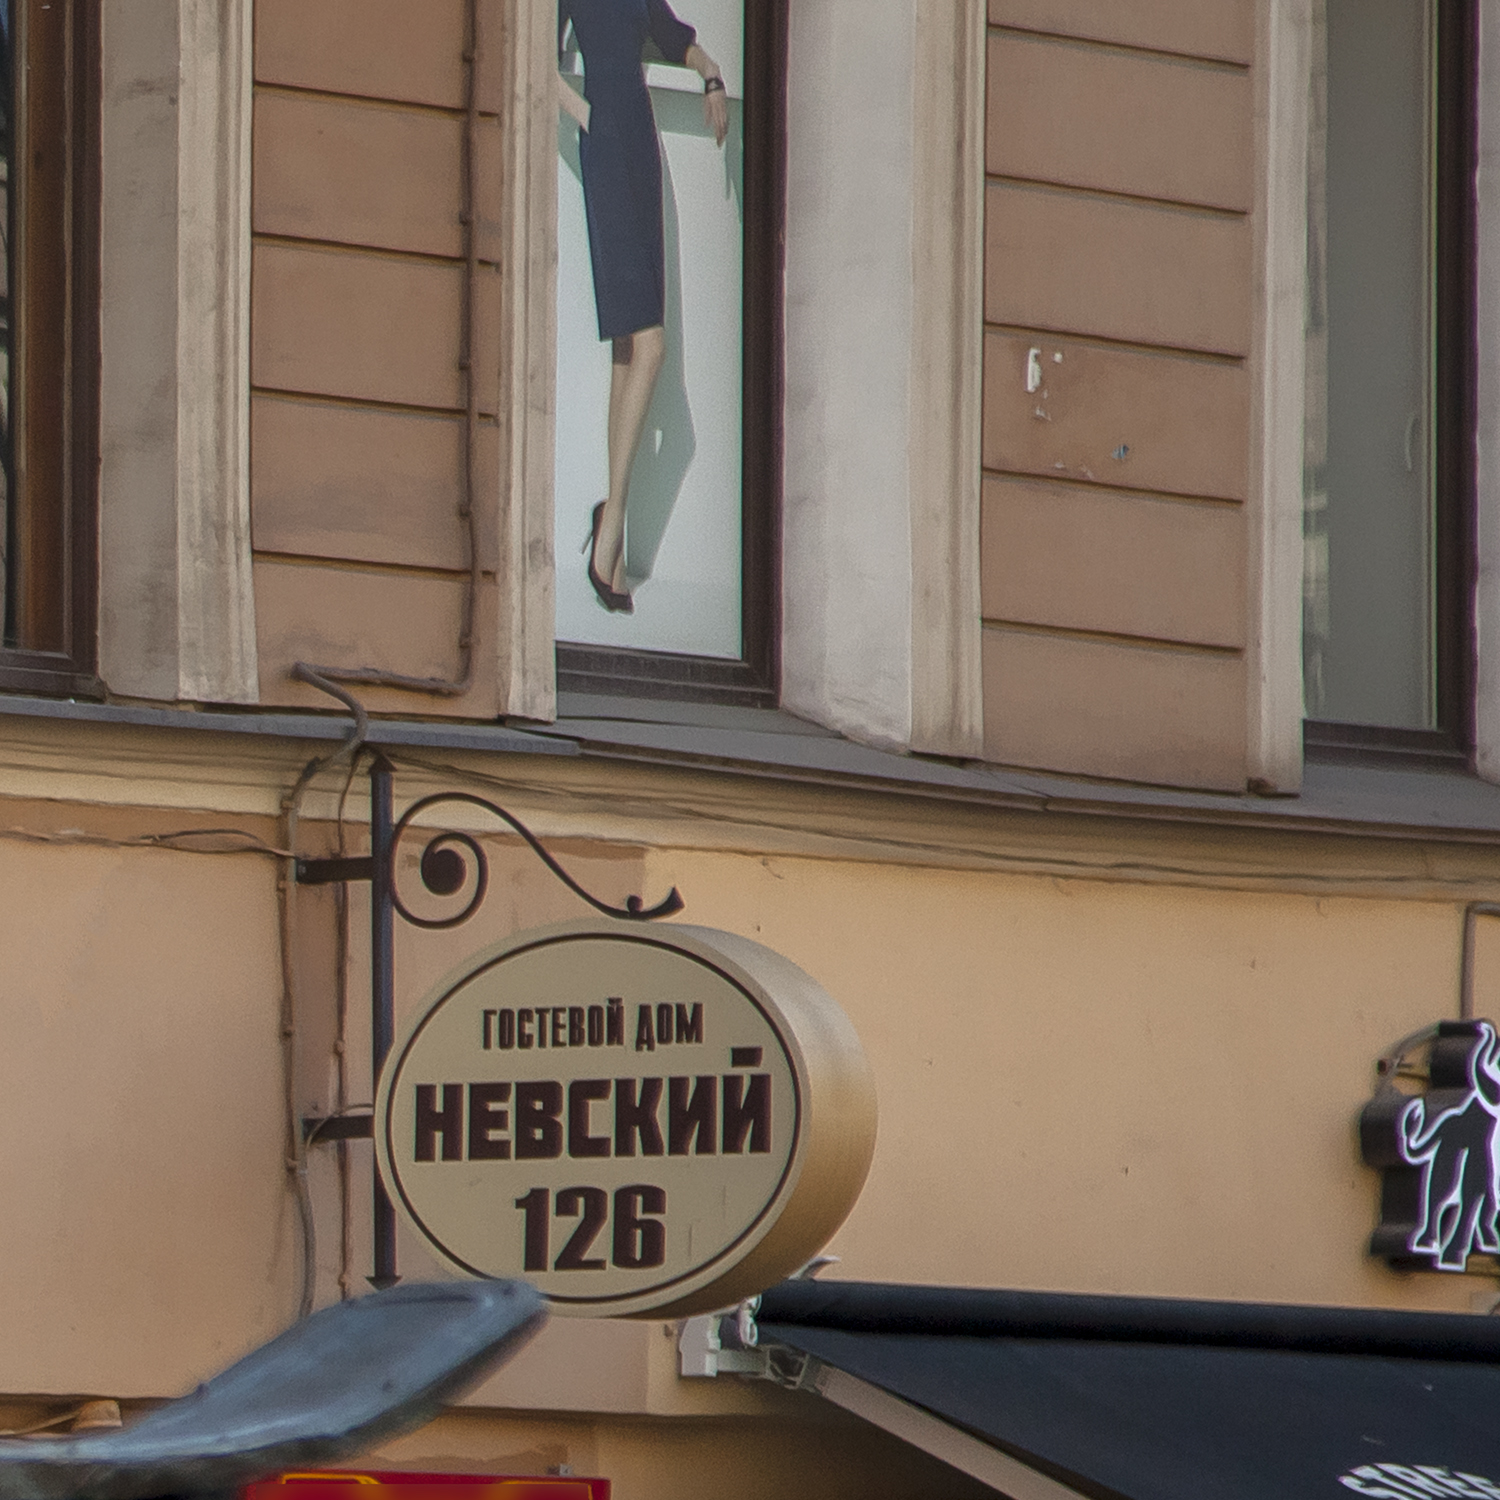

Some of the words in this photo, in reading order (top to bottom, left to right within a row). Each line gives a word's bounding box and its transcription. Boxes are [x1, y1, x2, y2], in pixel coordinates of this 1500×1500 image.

[482, 998, 625, 1049] ГОСТЕВОЙ
[635, 1003, 704, 1052] ДОМ
[414, 1046, 772, 1163] НЕВСКИЙ
[515, 1184, 667, 1272] 126
